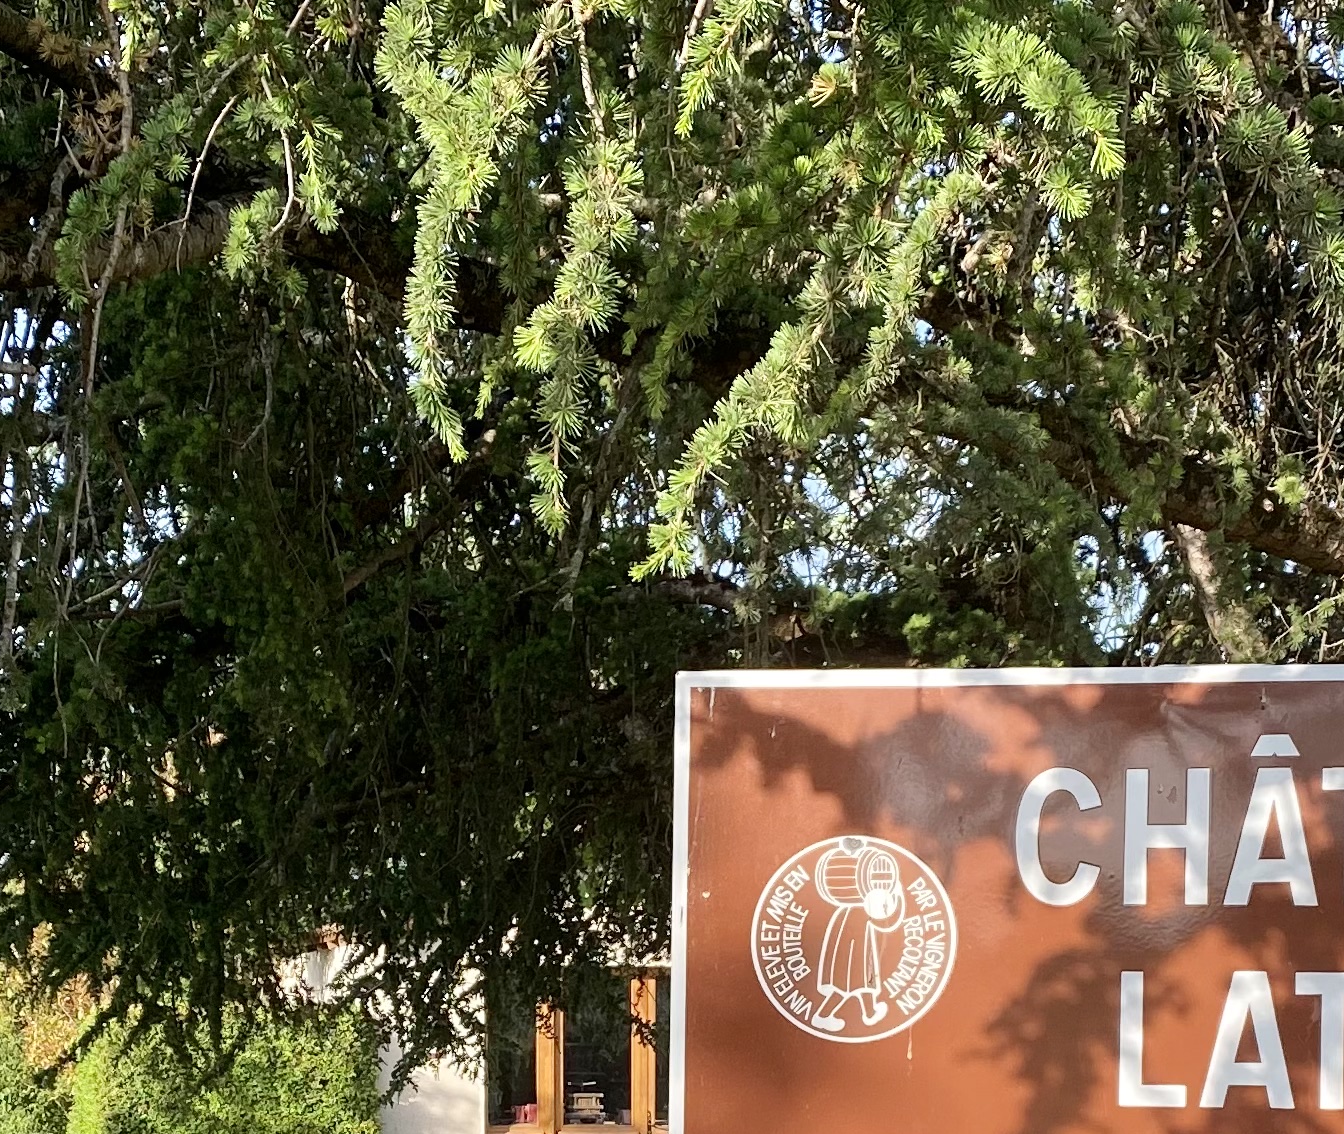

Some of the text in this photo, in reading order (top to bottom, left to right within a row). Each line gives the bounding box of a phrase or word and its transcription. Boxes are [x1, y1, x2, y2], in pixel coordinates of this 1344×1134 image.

[761, 864, 813, 1021] VIN ELEVE ET MIS EN
[783, 901, 811, 982] BOUTEILLE
[883, 915, 924, 999] RECOLTANT
[896, 876, 946, 1015] PAR LE VIGNERON
